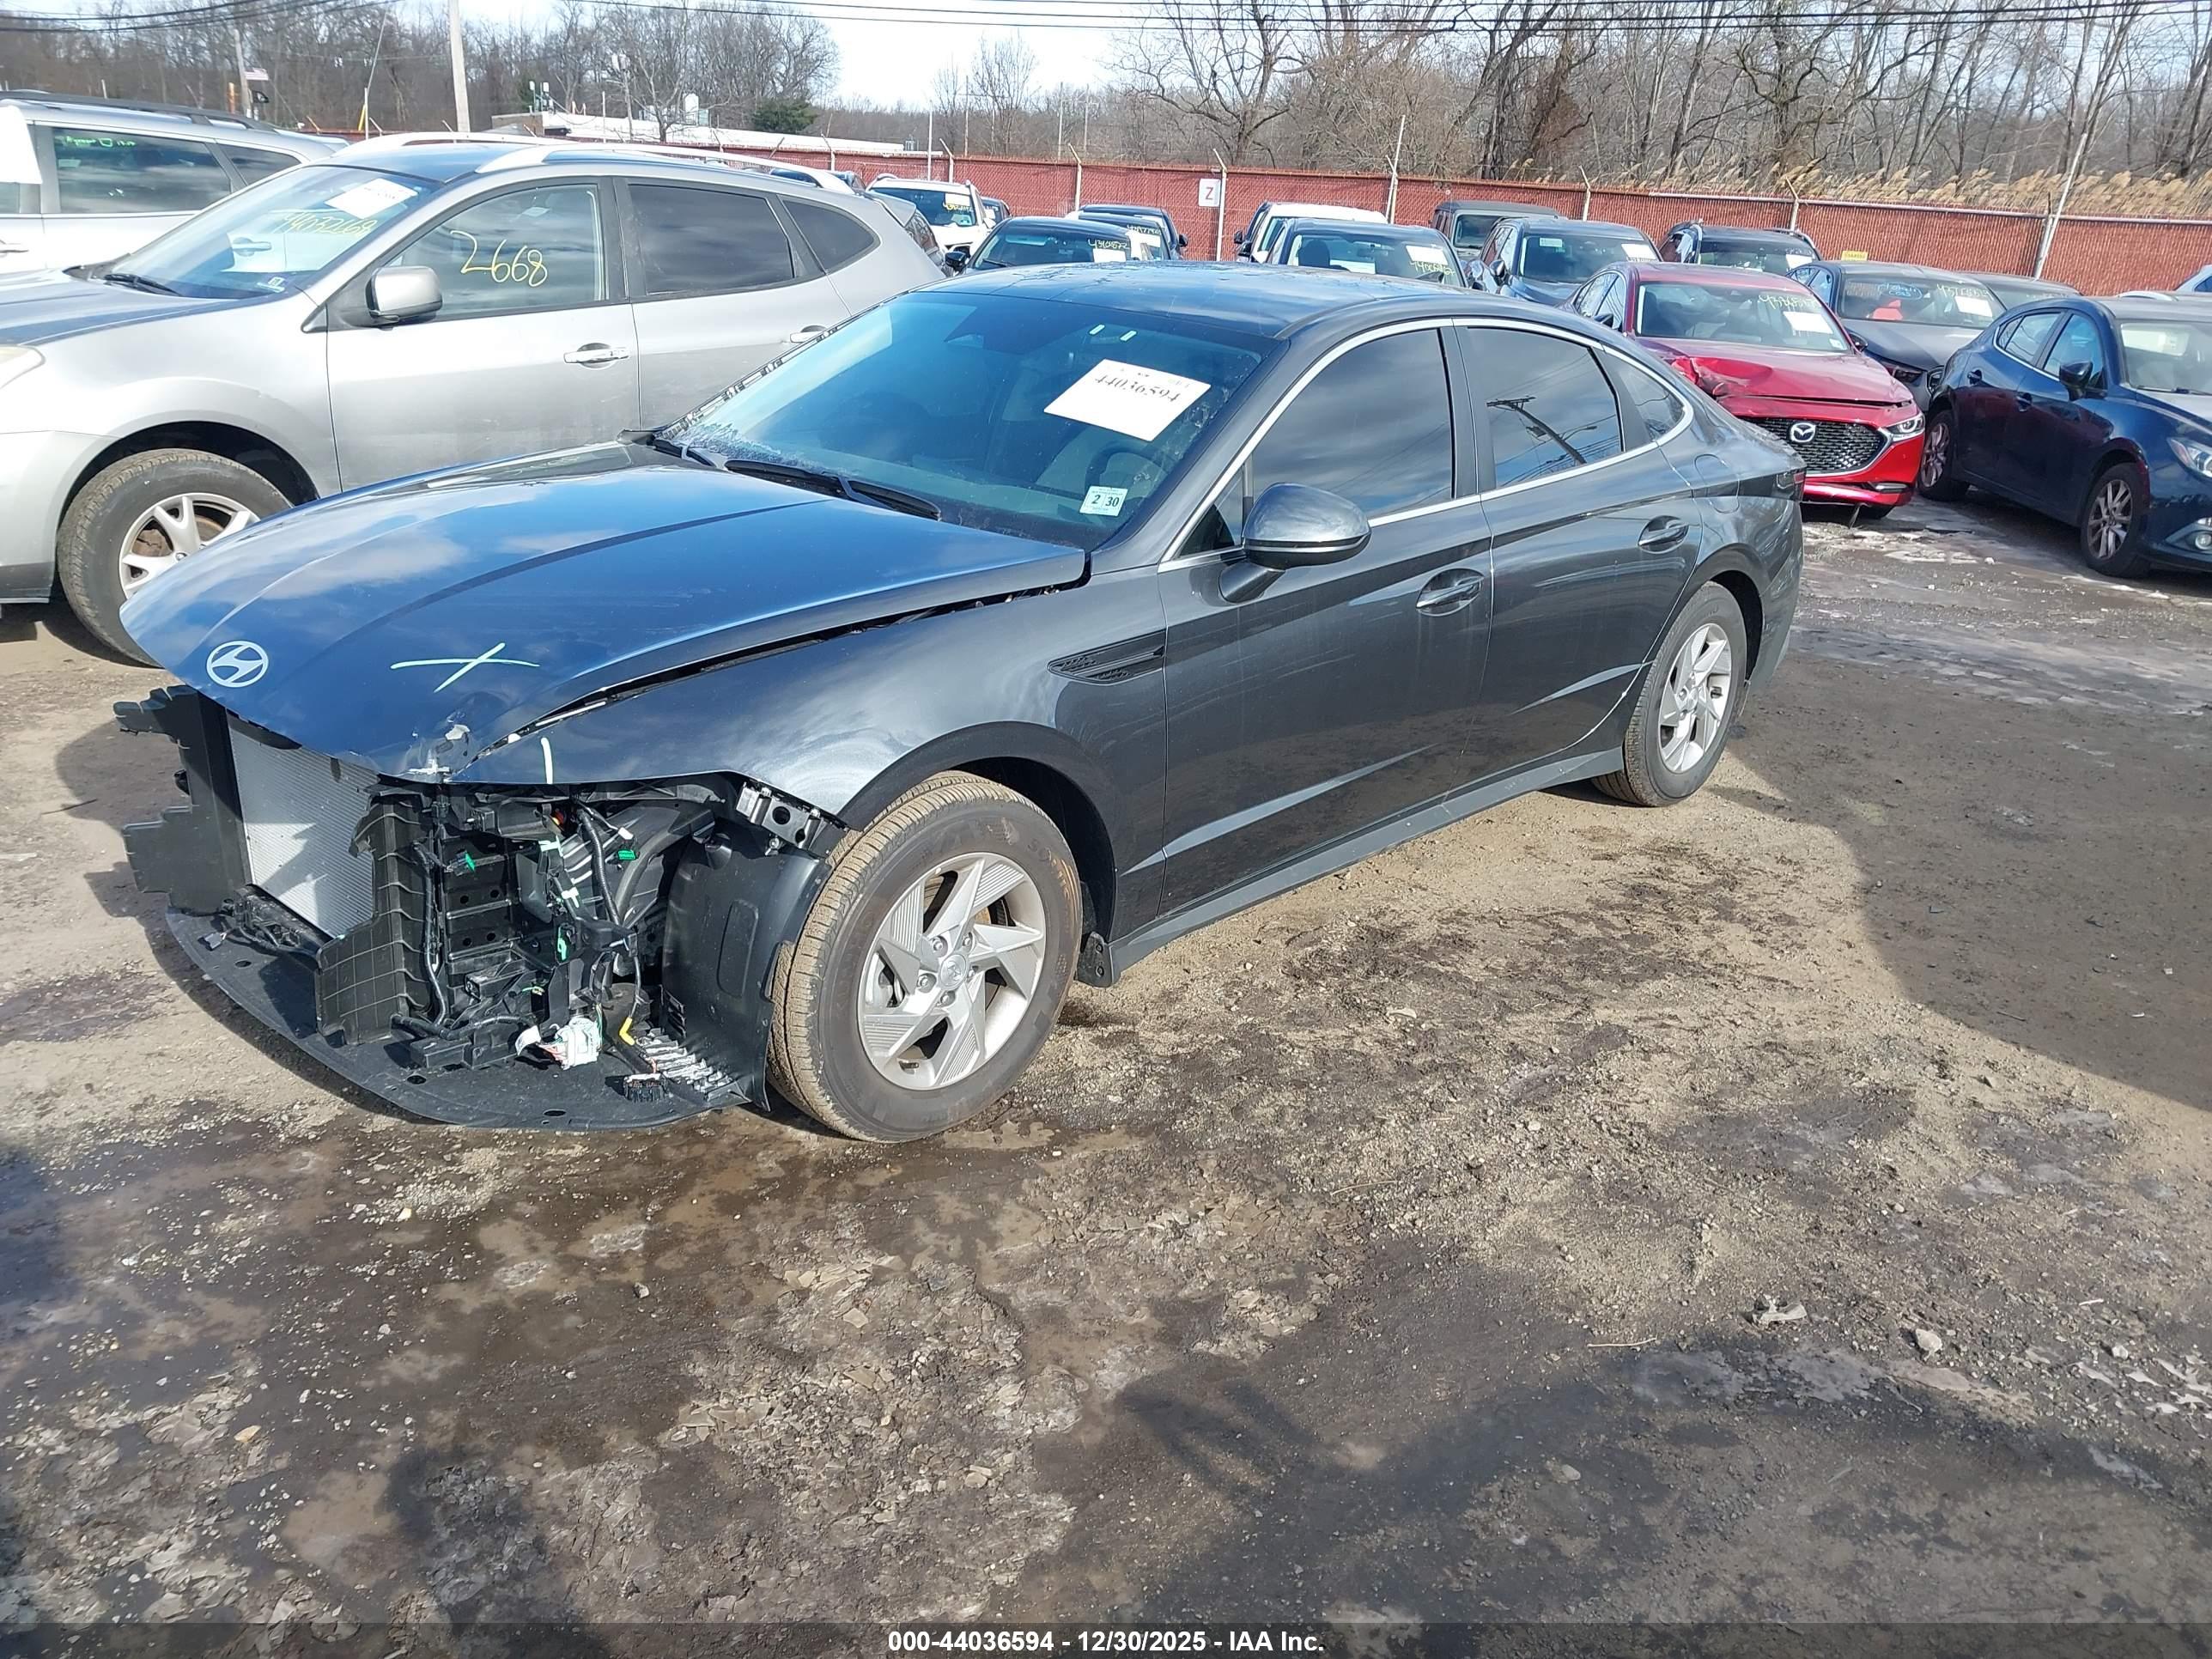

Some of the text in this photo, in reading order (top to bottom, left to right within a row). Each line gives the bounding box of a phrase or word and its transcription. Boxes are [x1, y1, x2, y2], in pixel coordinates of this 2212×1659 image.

[449, 229, 548, 287] 2668
[1095, 374, 1181, 403] 44036594
[1091, 494, 1120, 507] 2 30
